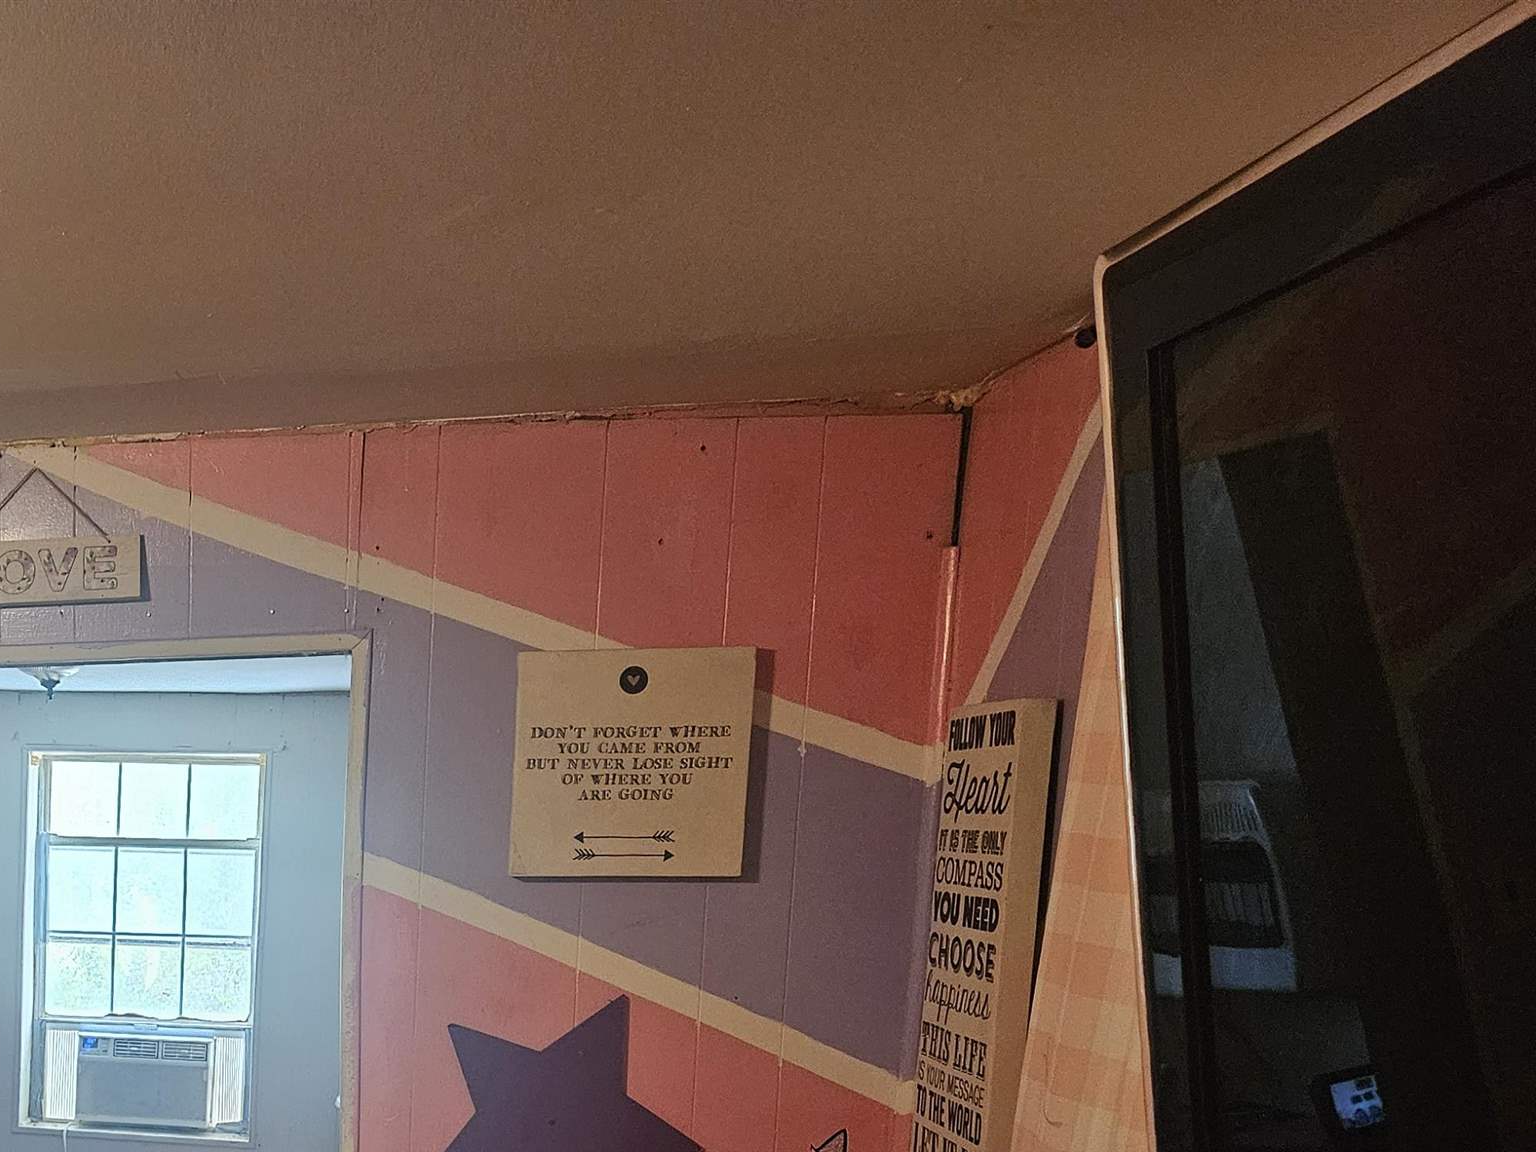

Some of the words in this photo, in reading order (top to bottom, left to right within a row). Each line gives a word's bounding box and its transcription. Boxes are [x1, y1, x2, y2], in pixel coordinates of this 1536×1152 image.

[530, 725, 586, 739] DON'T
[592, 725, 662, 739] FORGET
[669, 725, 732, 738] WHERE
[557, 742, 590, 754] YOU
[597, 742, 646, 754] CAME
[653, 741, 701, 753] FROM
[948, 713, 988, 752] FOLLOW
[989, 710, 1016, 748] YOUR
[526, 758, 560, 770] BUT
[566, 758, 625, 770] NEVER
[632, 757, 674, 769] LOSE
[680, 756, 733, 769] SIGHT
[561, 774, 584, 785] OF
[591, 774, 652, 786] WHERE
[659, 773, 693, 785] YOU
[578, 789, 612, 801] ARE
[618, 789, 674, 801] GOING
[944, 759, 1013, 823] Heart
[939, 828, 949, 852] IT
[949, 829, 960, 853] IS
[961, 829, 980, 854] THE
[981, 830, 1007, 857] ONLY
[936, 856, 1004, 892] COMPASS
[933, 890, 961, 926] YOU
[964, 895, 1000, 933] NEED
[928, 932, 996, 983] CHOOSE
[924, 969, 991, 1025] happiness
[921, 1020, 952, 1066] THIS
[952, 1033, 987, 1081] LIFE
[926, 1064, 945, 1091] YOUR
[946, 1073, 985, 1109] MESSAGE
[916, 1083, 927, 1117] TO
[928, 1090, 946, 1128] THE
[947, 1099, 982, 1146] WORLD
